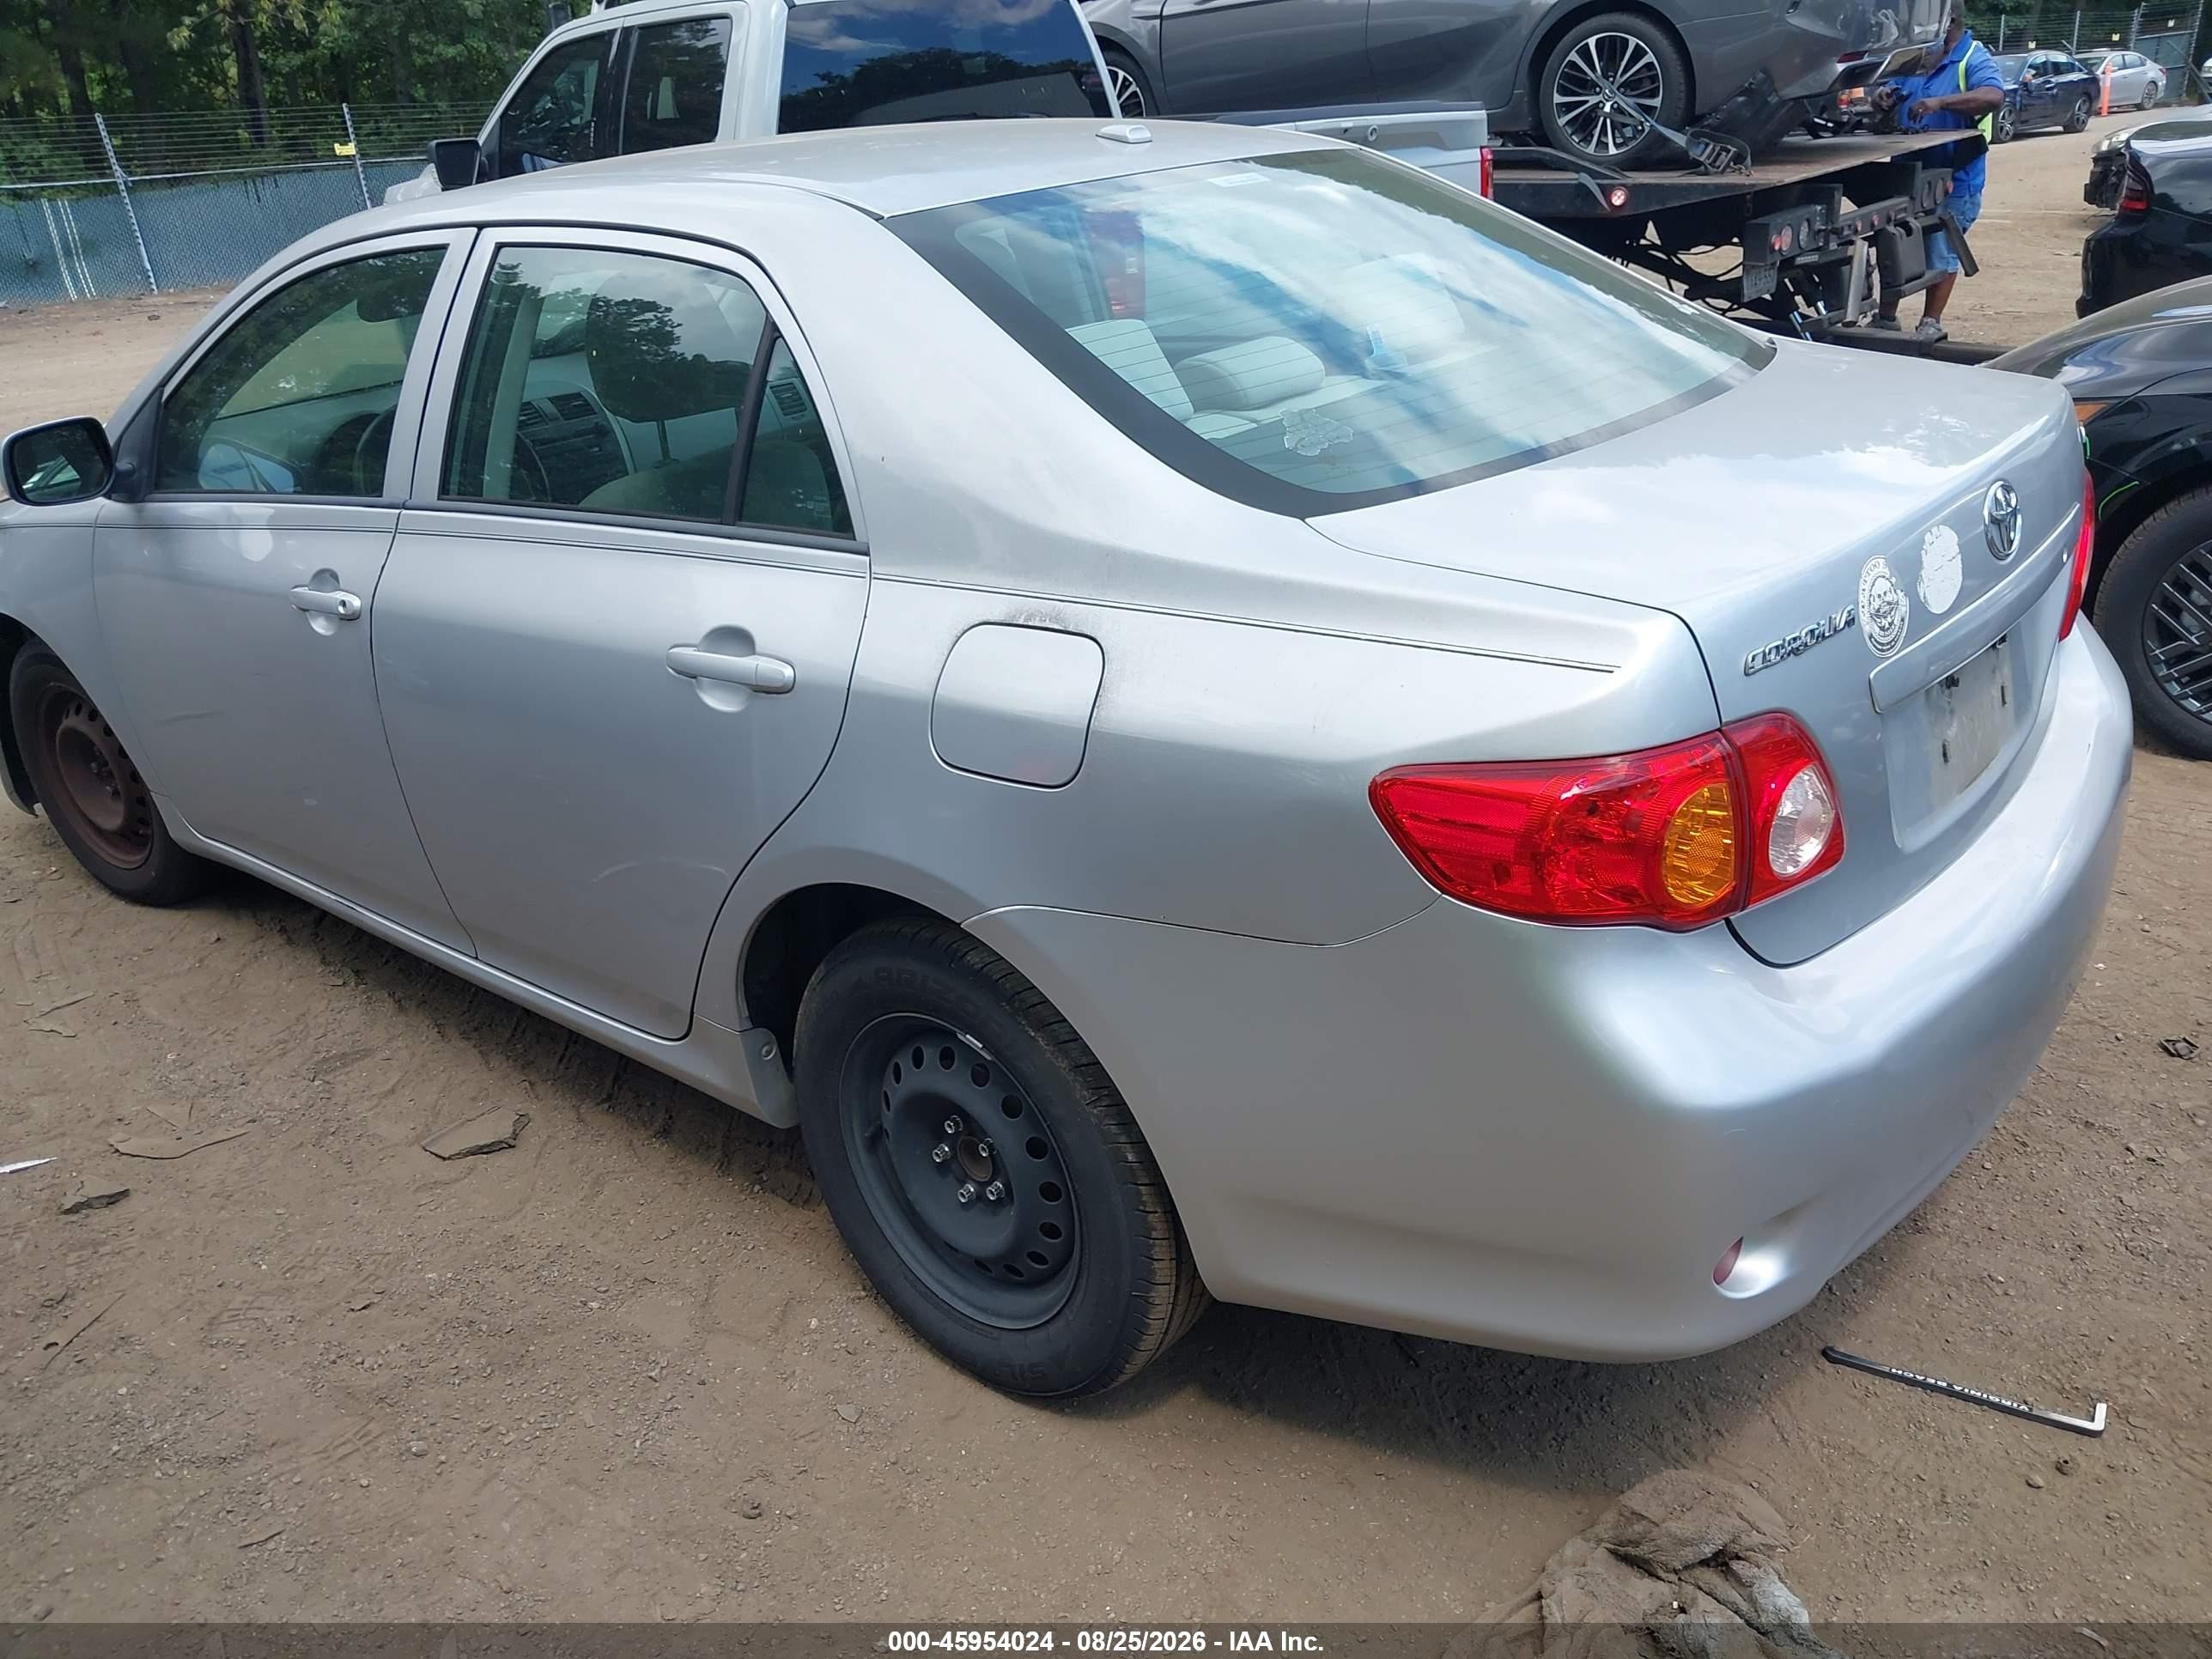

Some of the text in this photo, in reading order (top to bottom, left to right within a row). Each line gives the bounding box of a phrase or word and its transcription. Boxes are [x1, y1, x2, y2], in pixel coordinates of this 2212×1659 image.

[1744, 604, 1856, 676] COROLLA
[1890, 1368, 2030, 1412] VIRGINIA BEACH
